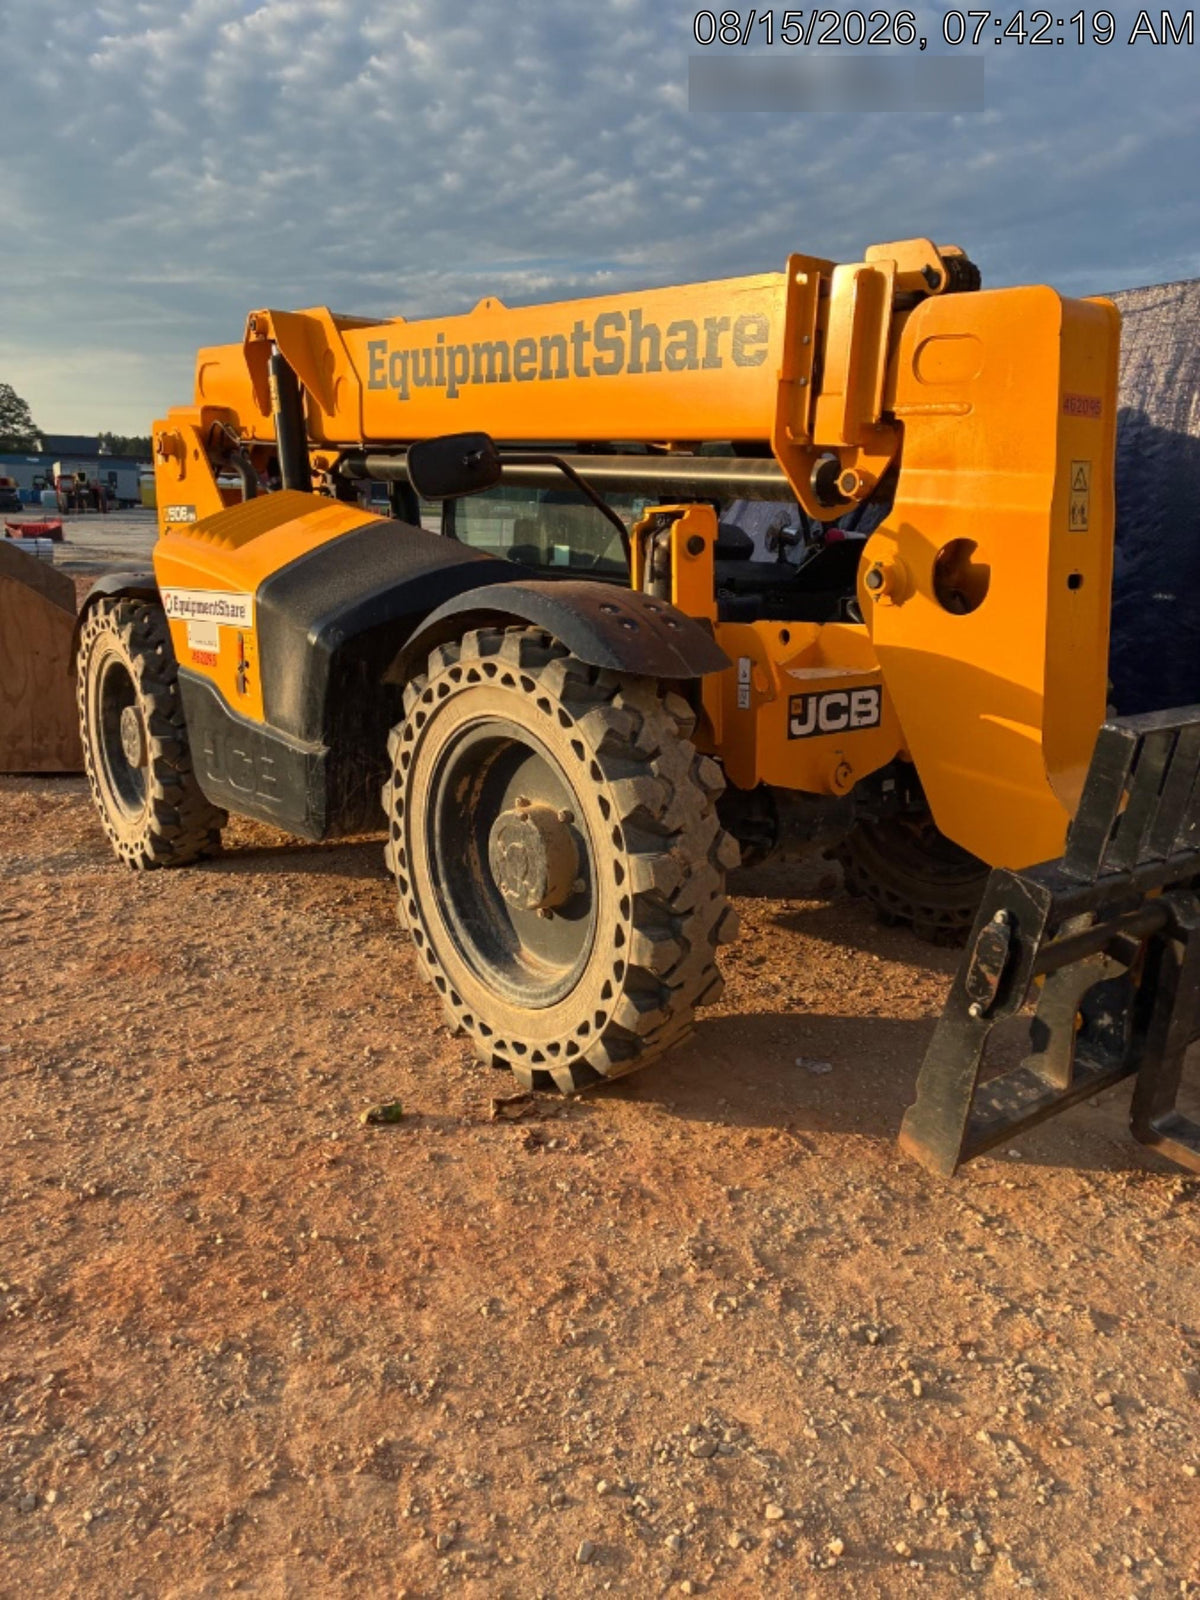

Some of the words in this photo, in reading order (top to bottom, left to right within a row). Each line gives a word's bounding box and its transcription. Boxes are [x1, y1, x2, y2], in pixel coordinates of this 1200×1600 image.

[367, 307, 770, 401] EquipmentShare
[173, 595, 246, 618] EquipmentShare
[790, 688, 880, 736] JCB
